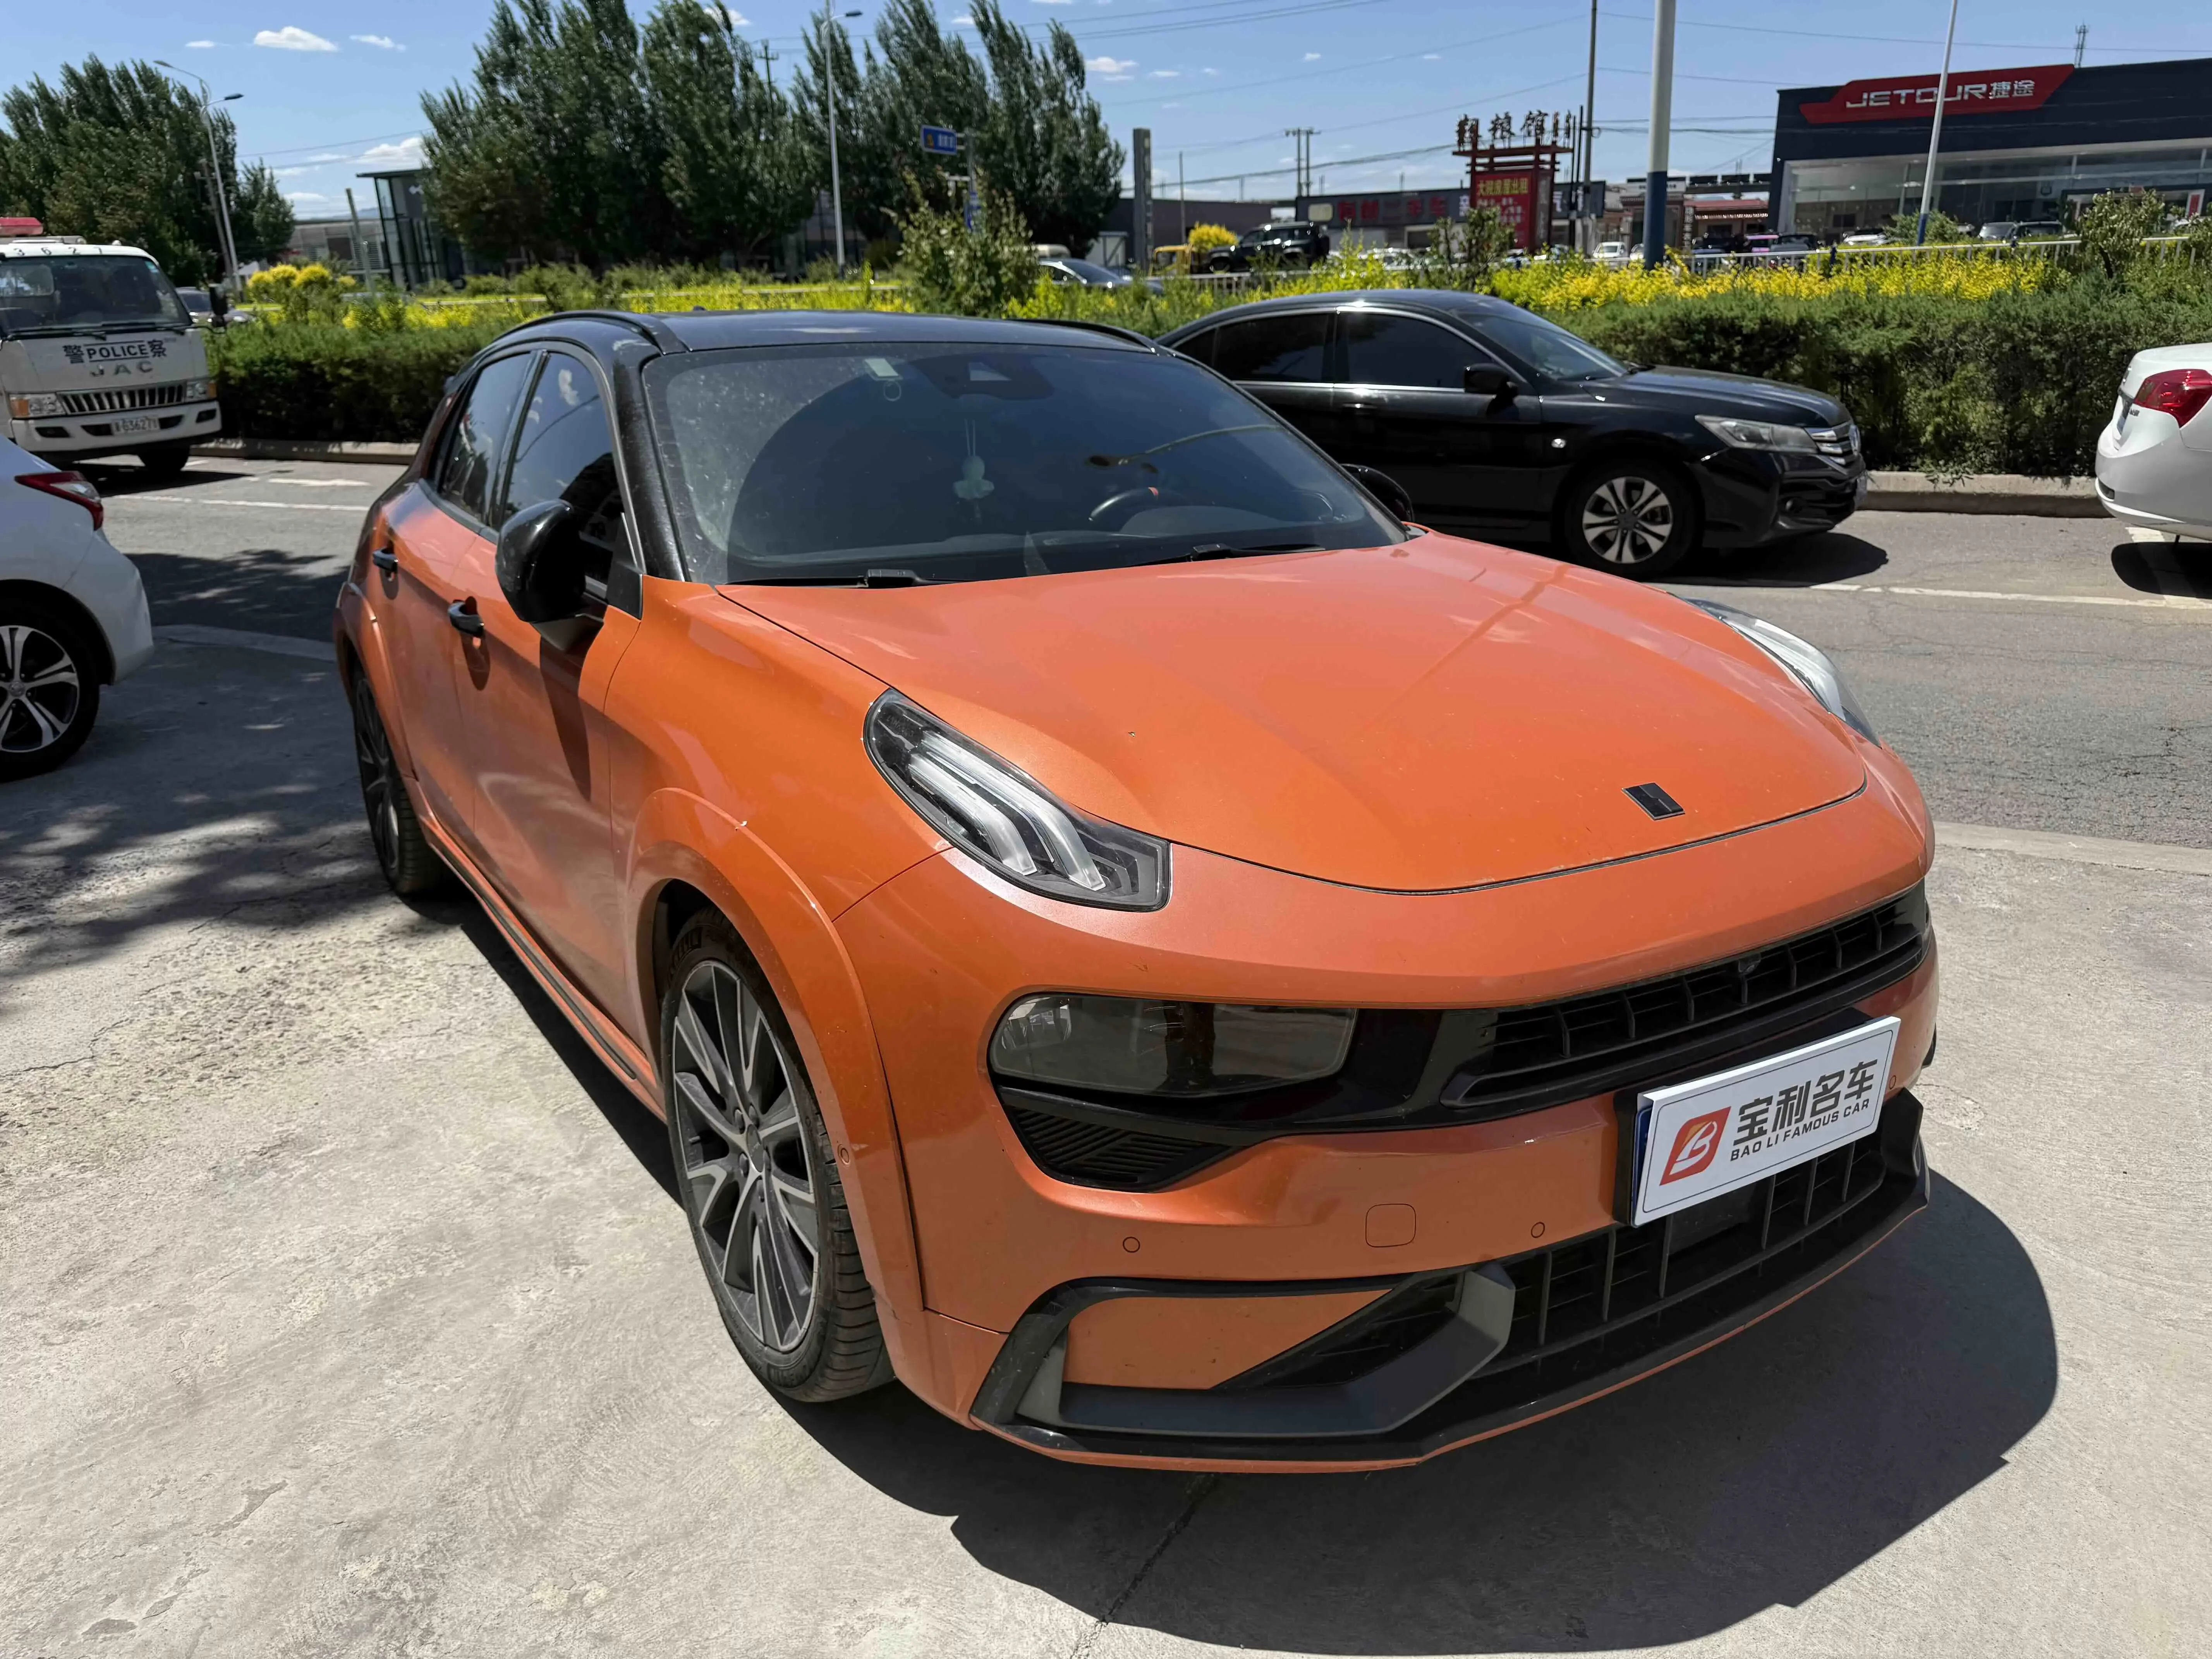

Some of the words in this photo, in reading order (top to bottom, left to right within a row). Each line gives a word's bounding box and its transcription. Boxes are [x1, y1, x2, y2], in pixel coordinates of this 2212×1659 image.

[1846, 84, 1987, 108] JETOUR
[1989, 80, 2035, 100] 捷途
[62, 344, 84, 364] 警
[86, 344, 149, 359] POLICE
[148, 339, 167, 358] 察
[89, 360, 153, 377] JAC
[1733, 1059, 1877, 1146] 宝利名车
[1730, 1141, 1762, 1162] BAO
[1766, 1134, 1779, 1148] LI
[1783, 1111, 1839, 1142] FAMOUS
[1843, 1098, 1870, 1118] CAR
